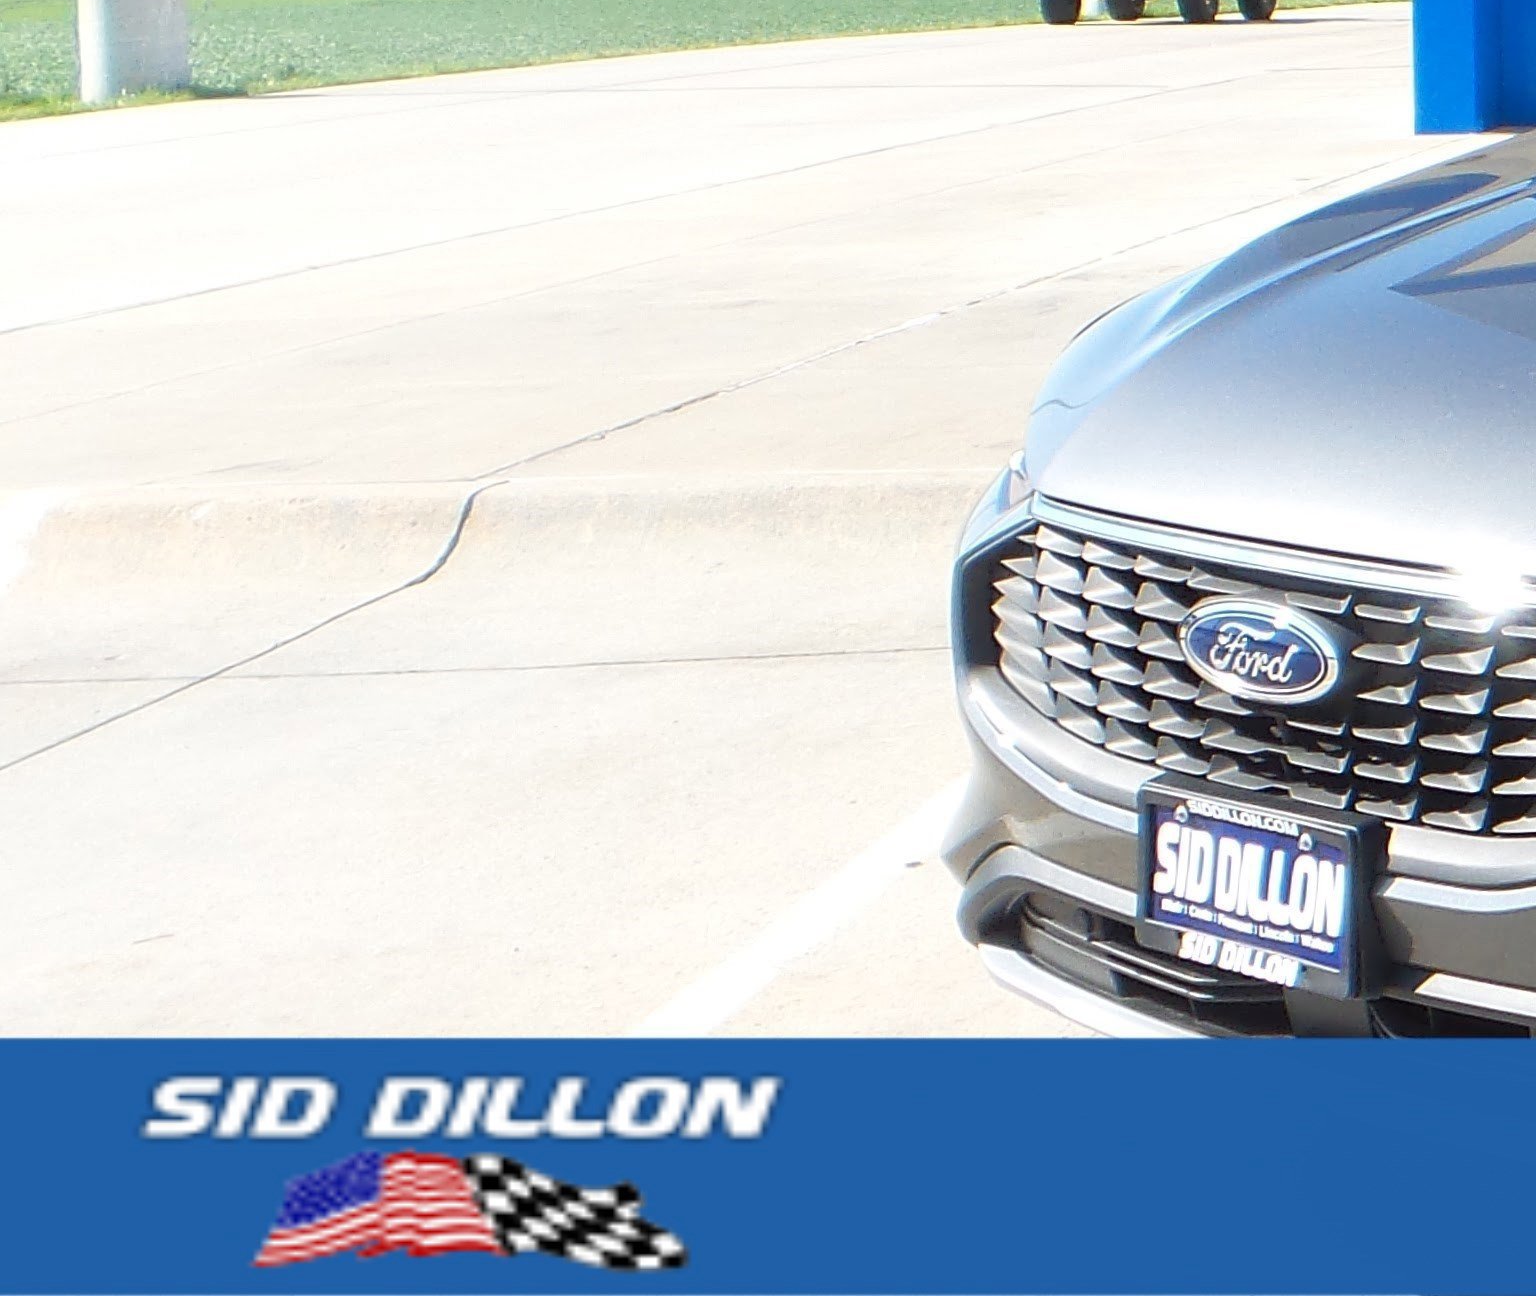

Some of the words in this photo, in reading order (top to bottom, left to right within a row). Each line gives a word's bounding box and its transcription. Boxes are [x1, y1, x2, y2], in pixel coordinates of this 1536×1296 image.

[1209, 621, 1299, 683] Ford
[1186, 799, 1299, 837] SIDDILLON.COM
[1153, 821, 1214, 905] SID
[1214, 836, 1345, 937] DILLON
[1178, 931, 1218, 966] SID
[1218, 943, 1300, 987] DILLON
